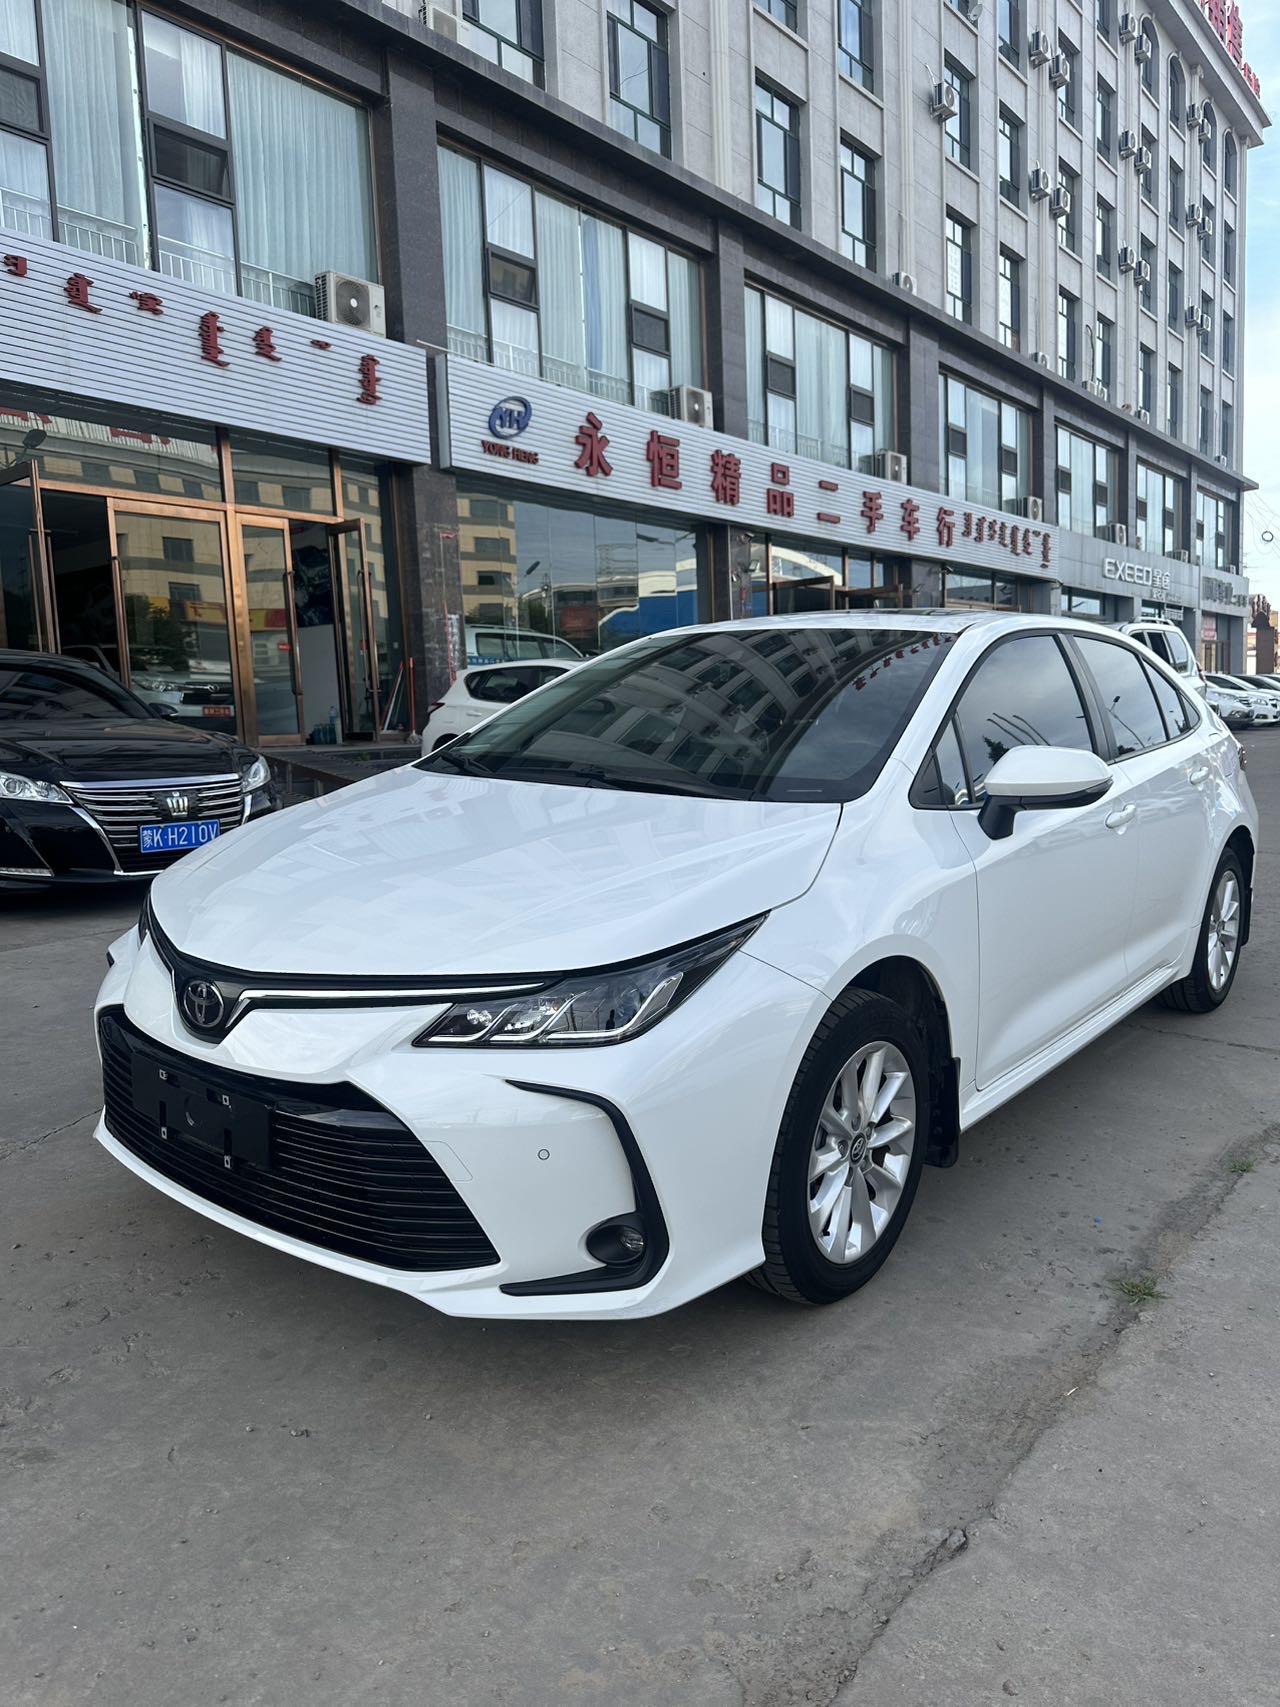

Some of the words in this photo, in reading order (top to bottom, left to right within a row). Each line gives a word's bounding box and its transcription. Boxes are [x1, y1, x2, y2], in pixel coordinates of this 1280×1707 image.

[481, 440, 510, 458] YONG
[511, 447, 539, 465] HENG
[574, 411, 956, 549] 永恒精品二手车行
[1103, 557, 1152, 587] EXEED
